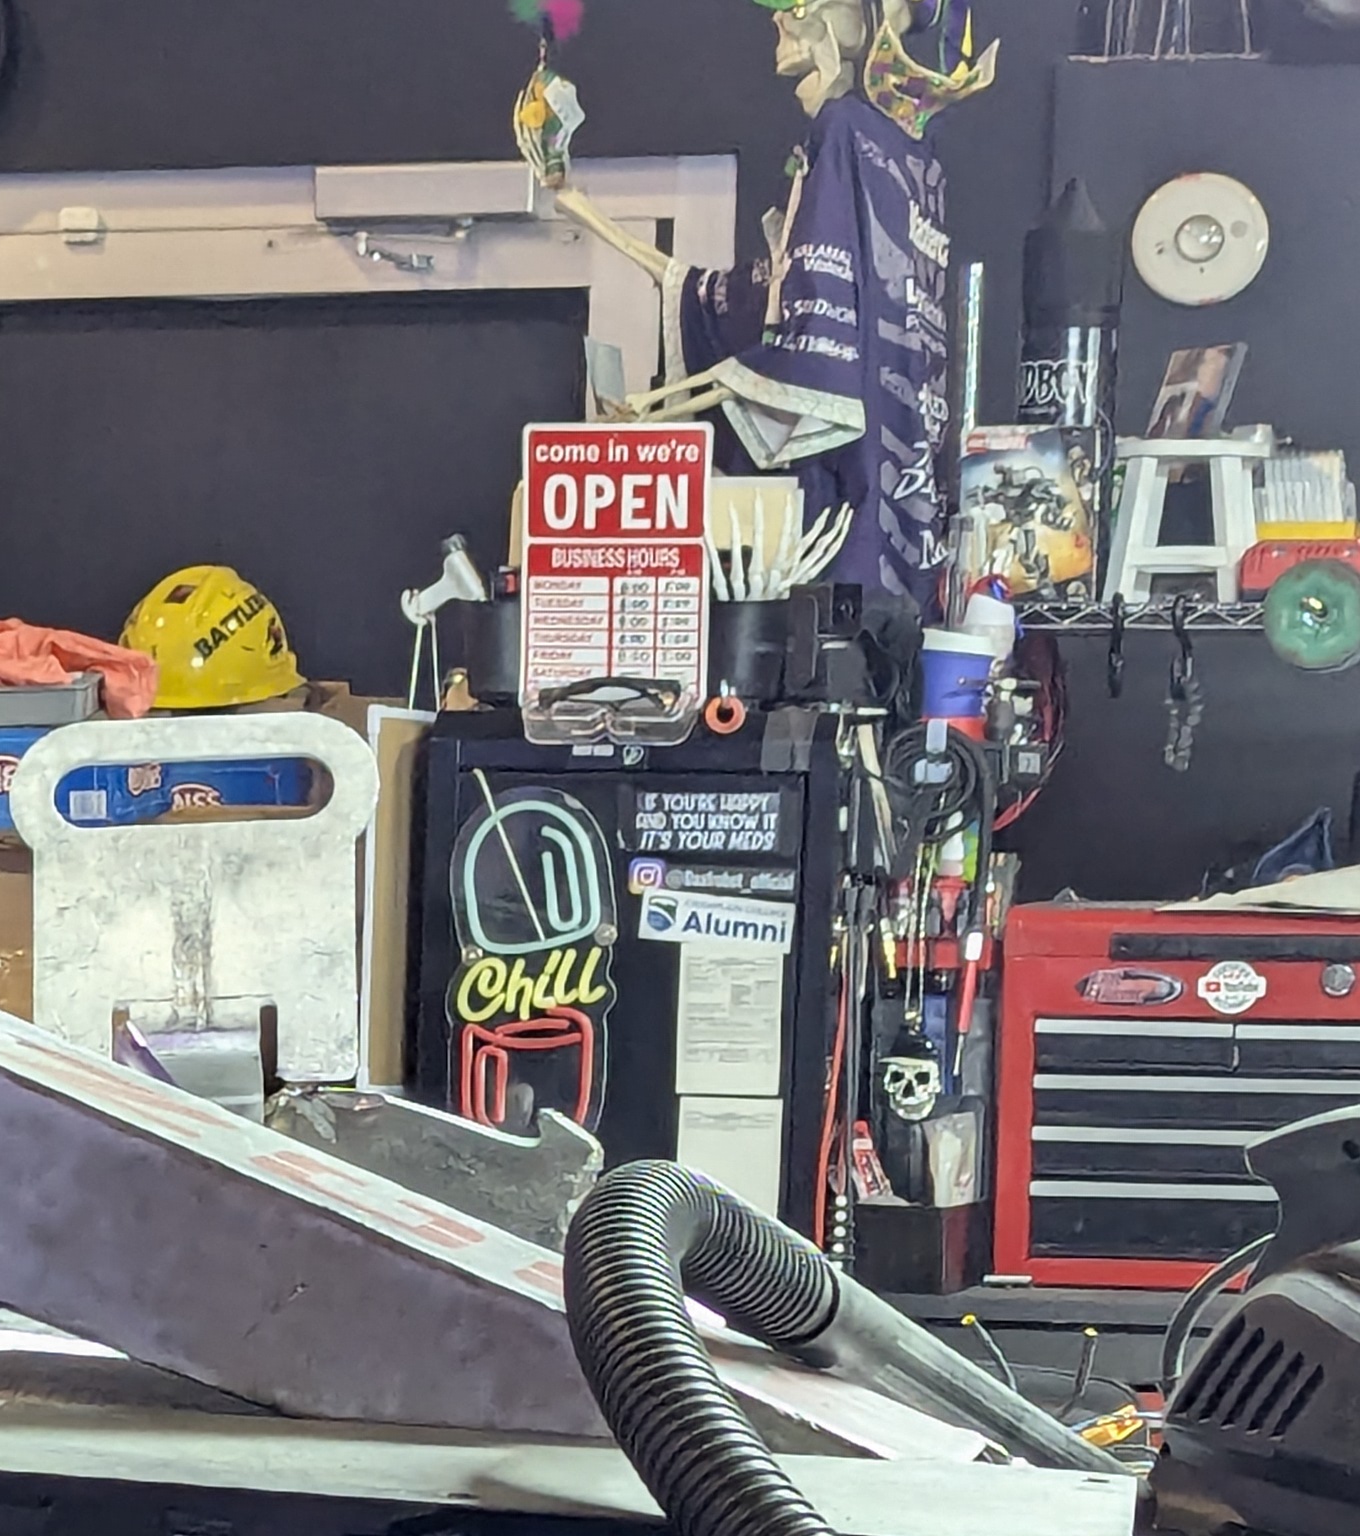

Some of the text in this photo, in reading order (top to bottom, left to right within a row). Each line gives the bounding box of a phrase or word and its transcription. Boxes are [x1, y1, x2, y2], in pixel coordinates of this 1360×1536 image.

[535, 439, 699, 464] come in we're
[543, 474, 689, 530] OPEN
[551, 547, 680, 568] BUSINESS HOURS
[661, 793, 716, 811] YOU'RE
[671, 813, 705, 829] YOU
[708, 813, 759, 829] KNOW
[763, 813, 778, 829] IT
[639, 831, 776, 850] IT'S YOUR MEDS
[682, 911, 787, 943] Alumni
[457, 947, 608, 1021] Chill
